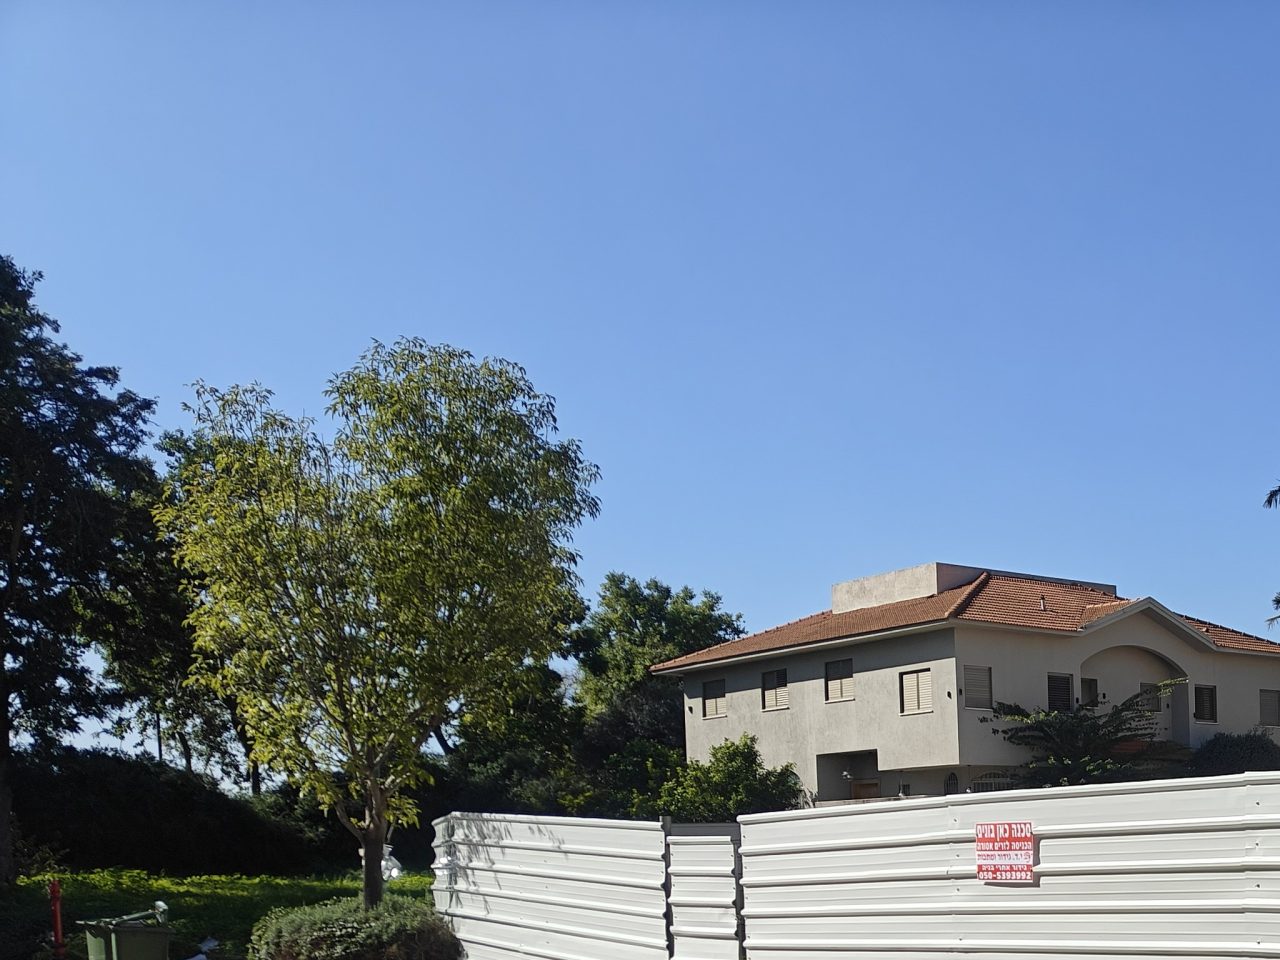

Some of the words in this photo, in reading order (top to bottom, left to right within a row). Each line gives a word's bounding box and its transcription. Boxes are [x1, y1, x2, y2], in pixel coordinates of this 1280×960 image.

[977, 825, 995, 838] בונים
[997, 824, 1009, 841] כאן
[1012, 823, 1031, 837] סכנה
